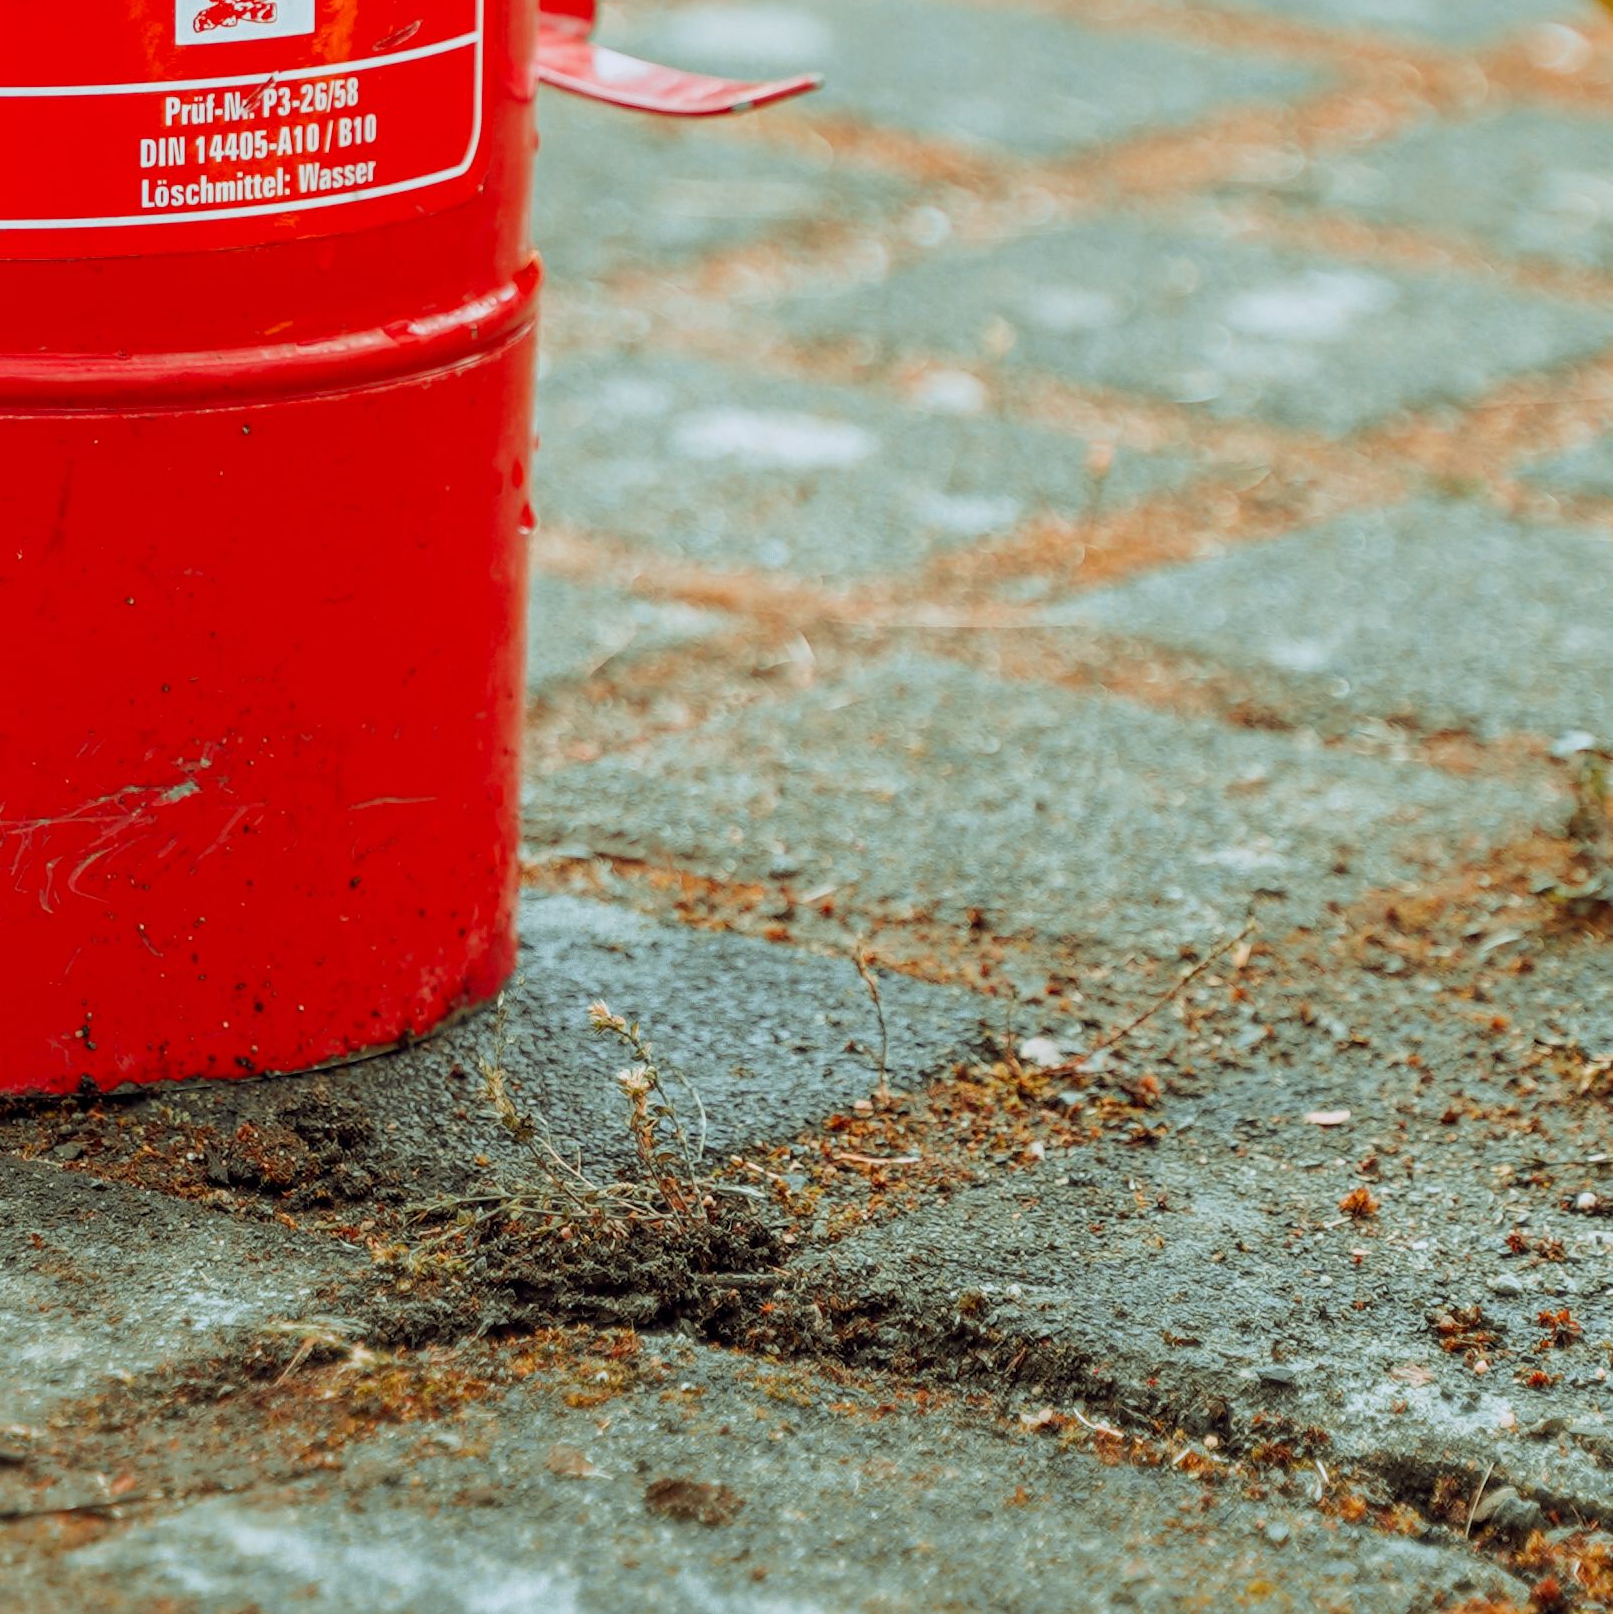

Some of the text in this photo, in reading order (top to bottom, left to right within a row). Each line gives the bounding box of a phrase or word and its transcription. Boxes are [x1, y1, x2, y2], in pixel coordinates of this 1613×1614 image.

[262, 78, 359, 118] P3-26/58
[140, 136, 185, 169] DIN
[194, 121, 319, 165] 14405-A10
[337, 114, 377, 148] B10
[140, 160, 376, 209] Löschmittel: Wasser
